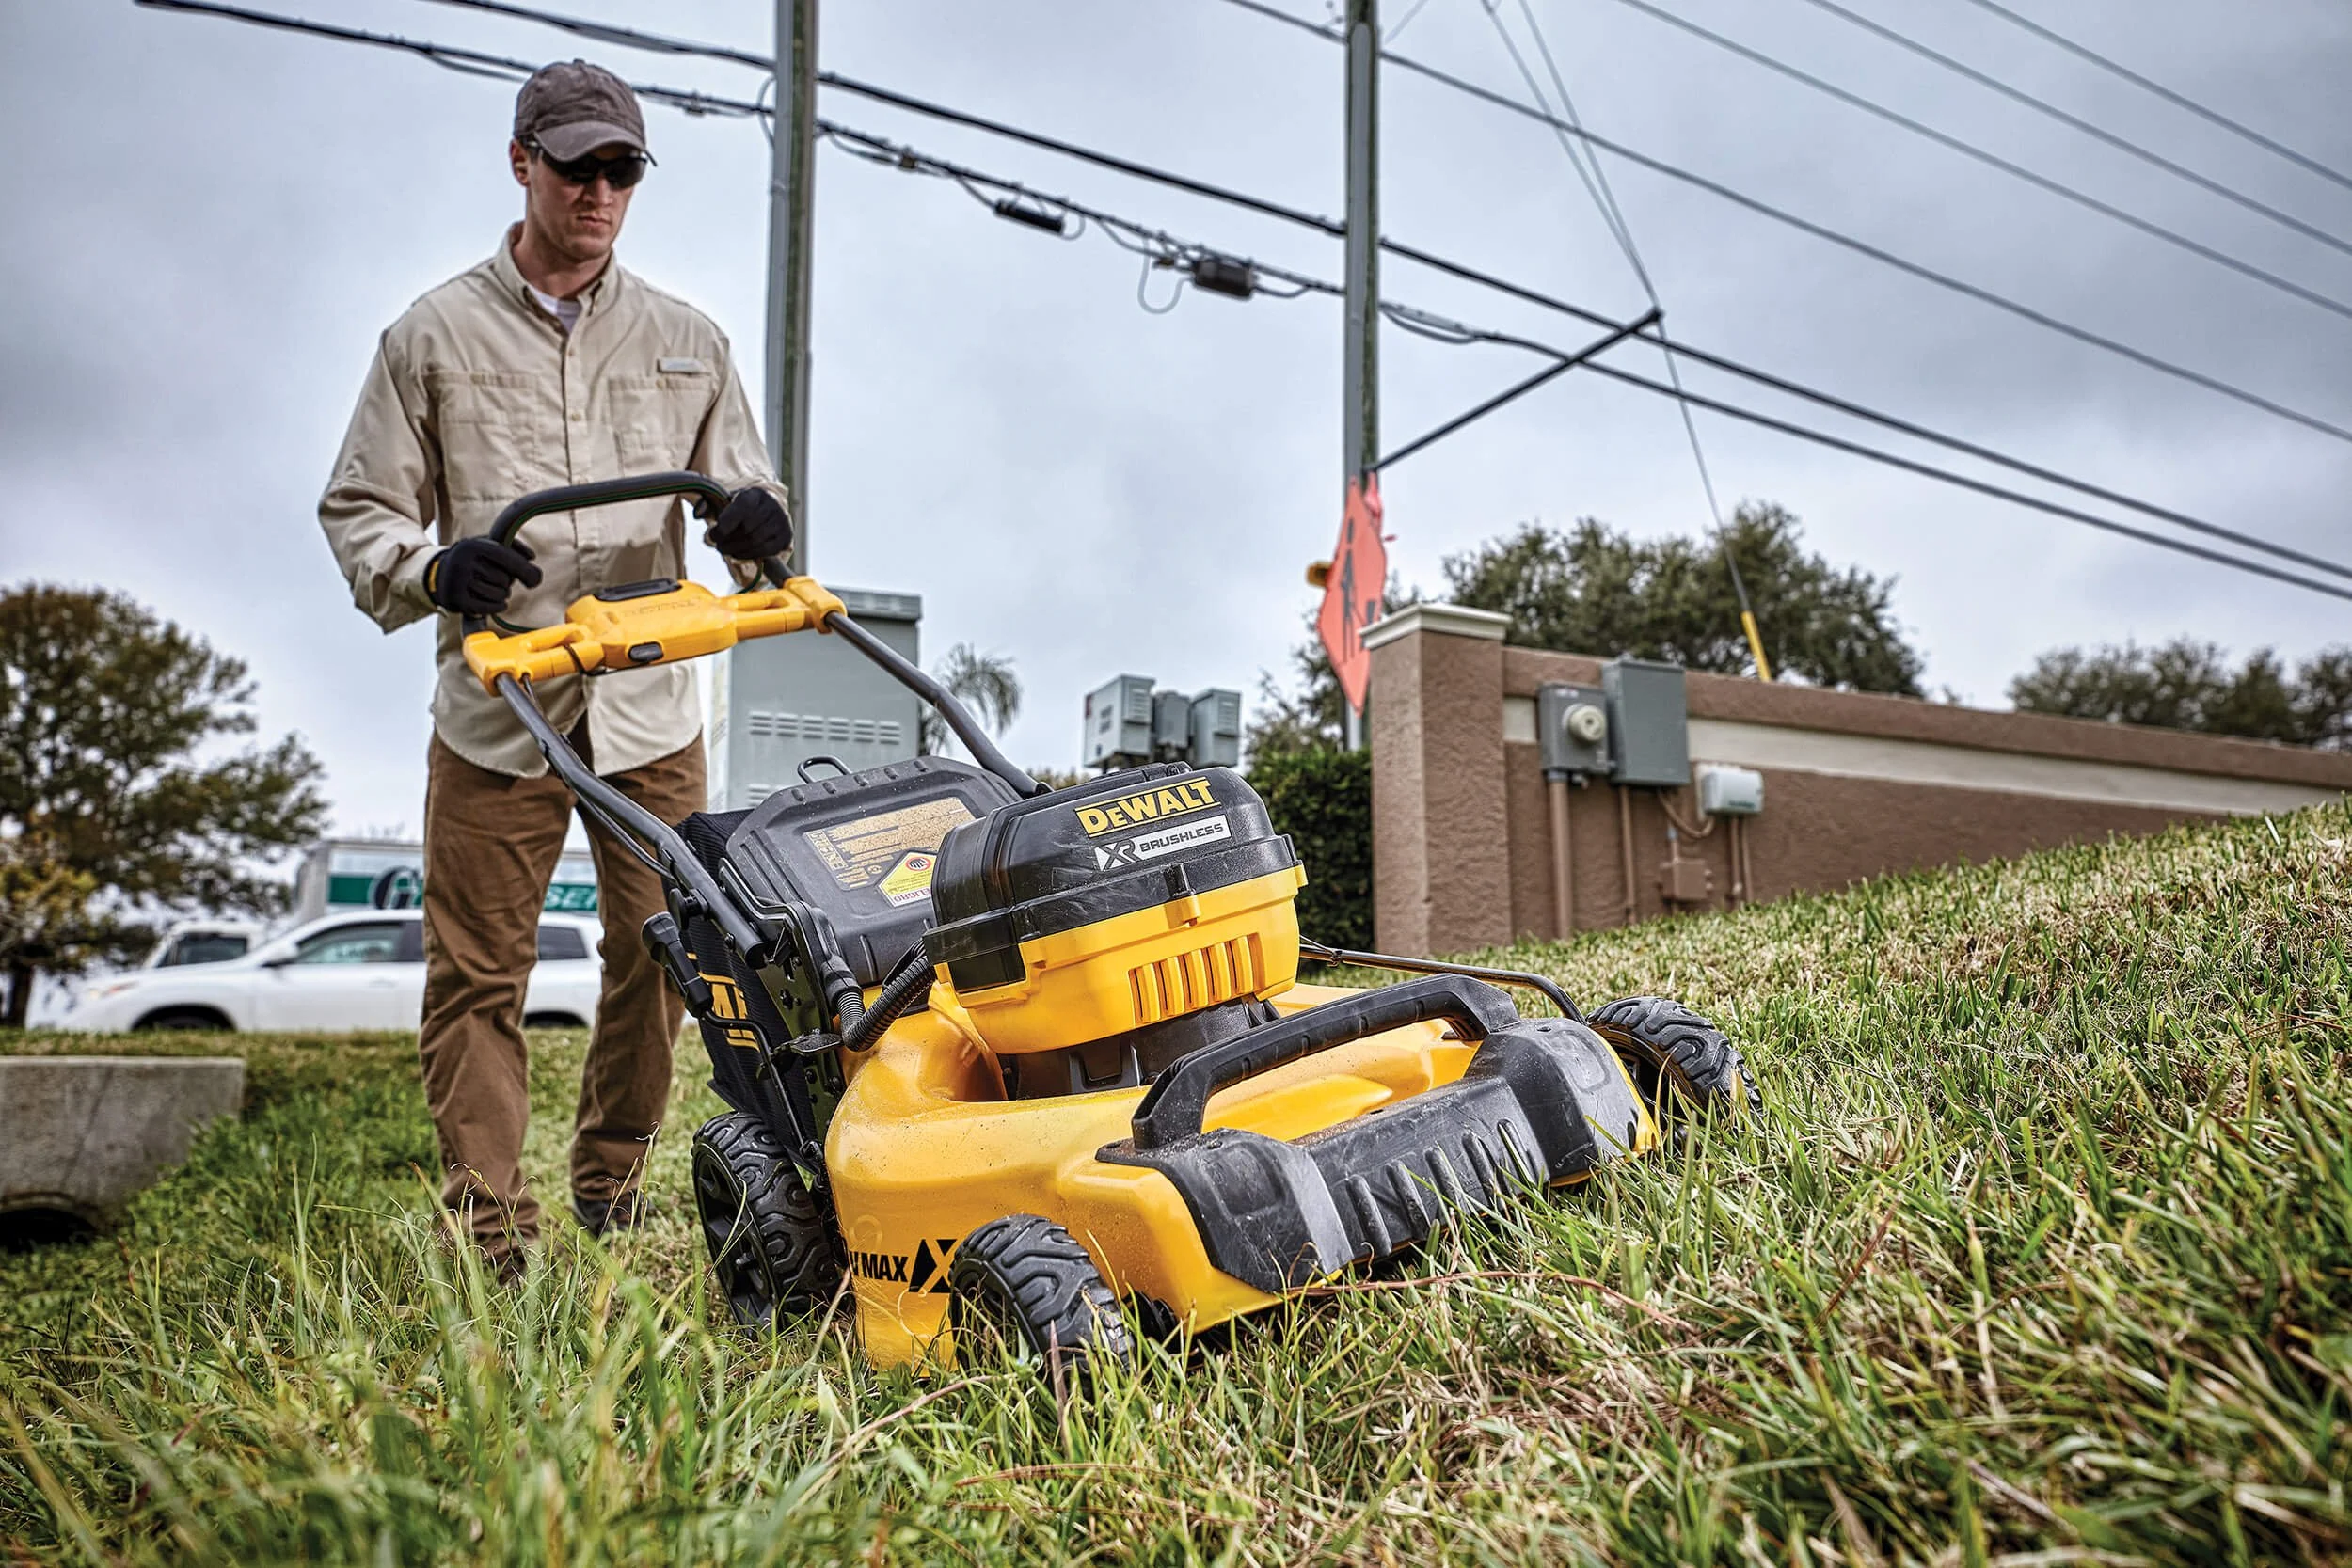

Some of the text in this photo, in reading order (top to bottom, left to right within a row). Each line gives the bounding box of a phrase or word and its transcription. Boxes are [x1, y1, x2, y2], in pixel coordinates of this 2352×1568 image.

[1077, 780, 1216, 833] DEWALT
[1140, 824, 1224, 853] BRUSHLESS
[893, 887, 930, 902] ELIGRO
[861, 1252, 909, 1282] MAX
